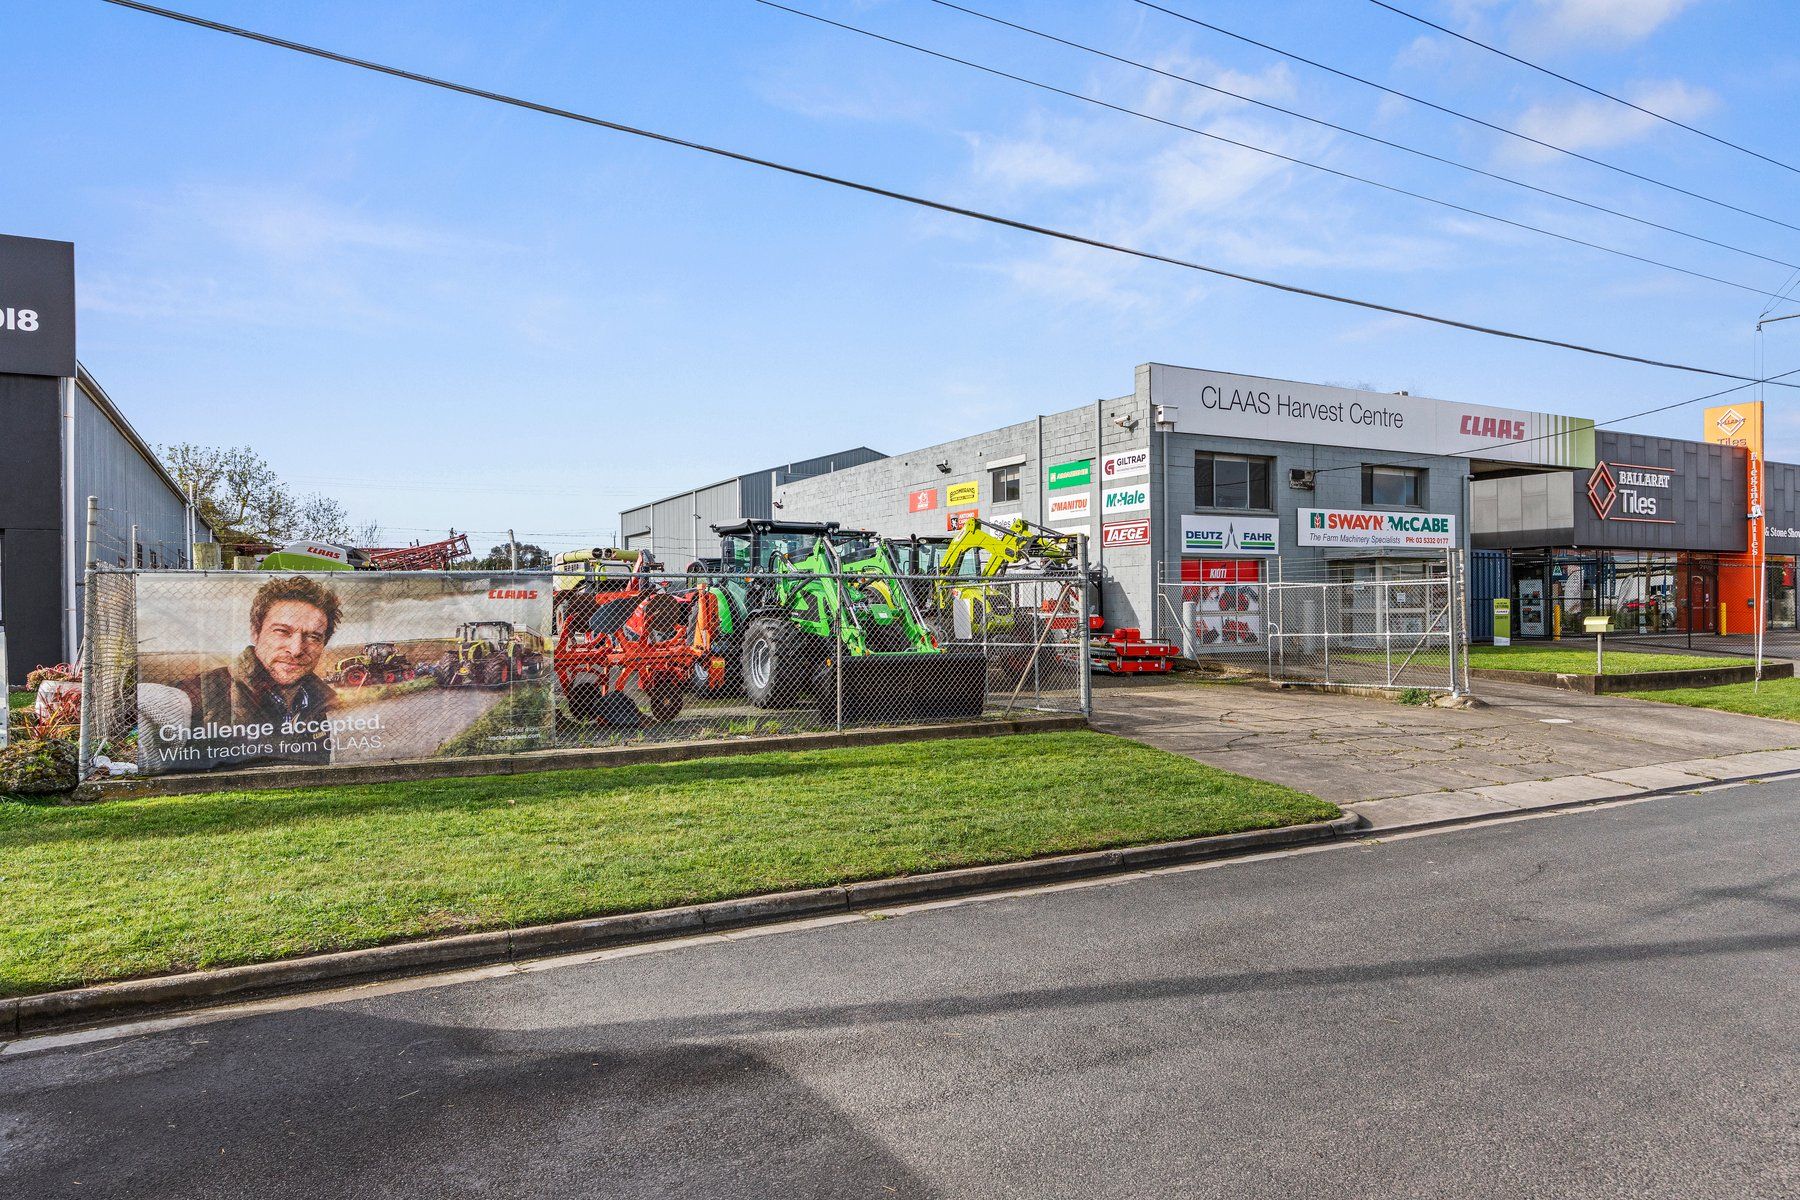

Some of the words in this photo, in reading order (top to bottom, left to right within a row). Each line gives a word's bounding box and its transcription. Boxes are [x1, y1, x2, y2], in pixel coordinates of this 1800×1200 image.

[1201, 385, 1271, 415] CLAAS
[1277, 394, 1343, 423] Harvest
[1349, 403, 1404, 429] Centre
[1459, 414, 1527, 441] CLAAS
[1716, 438, 1747, 447] Tiles
[1117, 454, 1146, 466] GILTRAP
[1619, 471, 1670, 488] BALLARAT
[1056, 499, 1087, 511] MANITOU
[1619, 489, 1657, 515] Tiles
[1328, 513, 1384, 531] SWAYN
[1387, 516, 1449, 533] McCABE
[1106, 528, 1145, 542] TAEGE
[1185, 530, 1223, 540] DEUTZ
[1244, 532, 1272, 541] FAHR
[1310, 533, 1321, 541] The
[1323, 534, 1338, 542] Farm
[1340, 534, 1369, 544] Machinery
[1371, 535, 1400, 545] Specialists
[1770, 527, 1787, 537] Stone
[1788, 528, 1800, 538] Sho
[307, 546, 341, 559] CLAAS
[488, 589, 538, 599] CLAAS
[159, 721, 274, 742] Challenge
[281, 714, 386, 737] accepted.
[159, 747, 201, 762] With
[207, 742, 273, 758] tractors
[278, 738, 317, 753] from
[323, 735, 386, 751] CLAAS.
